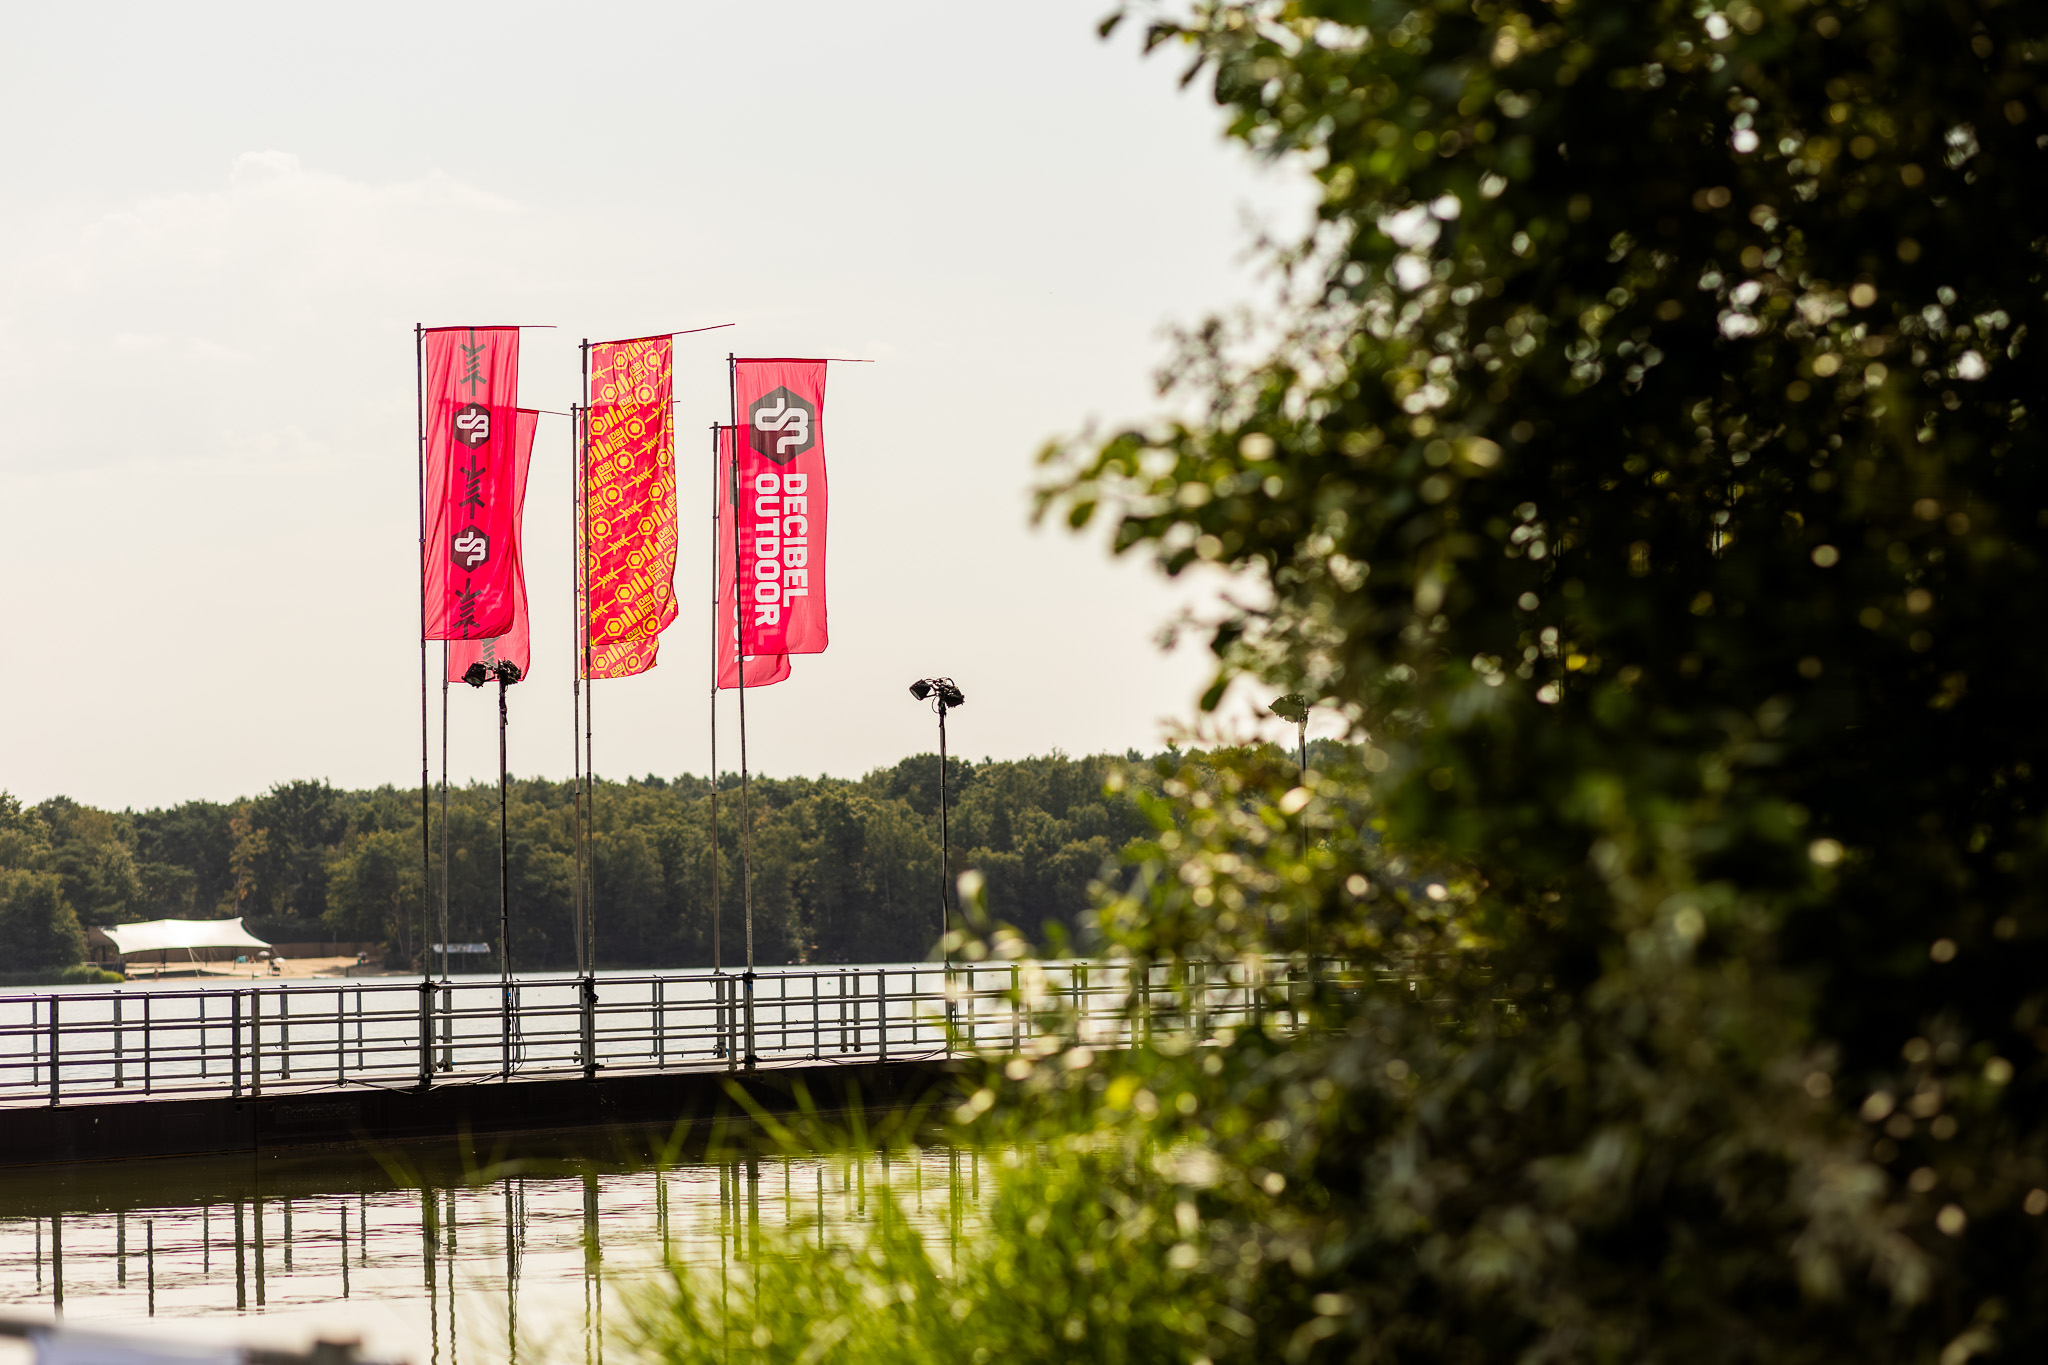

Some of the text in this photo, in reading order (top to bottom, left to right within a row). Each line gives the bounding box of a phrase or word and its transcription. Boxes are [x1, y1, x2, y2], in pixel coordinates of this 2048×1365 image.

[630, 361, 641, 373] DB
[636, 372, 646, 382] NL
[621, 395, 633, 406] DB
[626, 405, 637, 416] NL
[610, 428, 621, 440] DB
[614, 439, 627, 450] NL
[598, 462, 610, 473] DB
[603, 472, 616, 483] NL
[592, 505, 604, 517] NL
[658, 526, 670, 539] DB
[663, 537, 676, 549] NL
[783, 473, 808, 607] DECIBEL
[755, 473, 780, 627] OUTDOOR
[648, 560, 660, 572] DB
[654, 570, 666, 581] NL
[638, 594, 650, 606] DB
[643, 604, 655, 615] NL
[625, 641, 637, 653] NL
